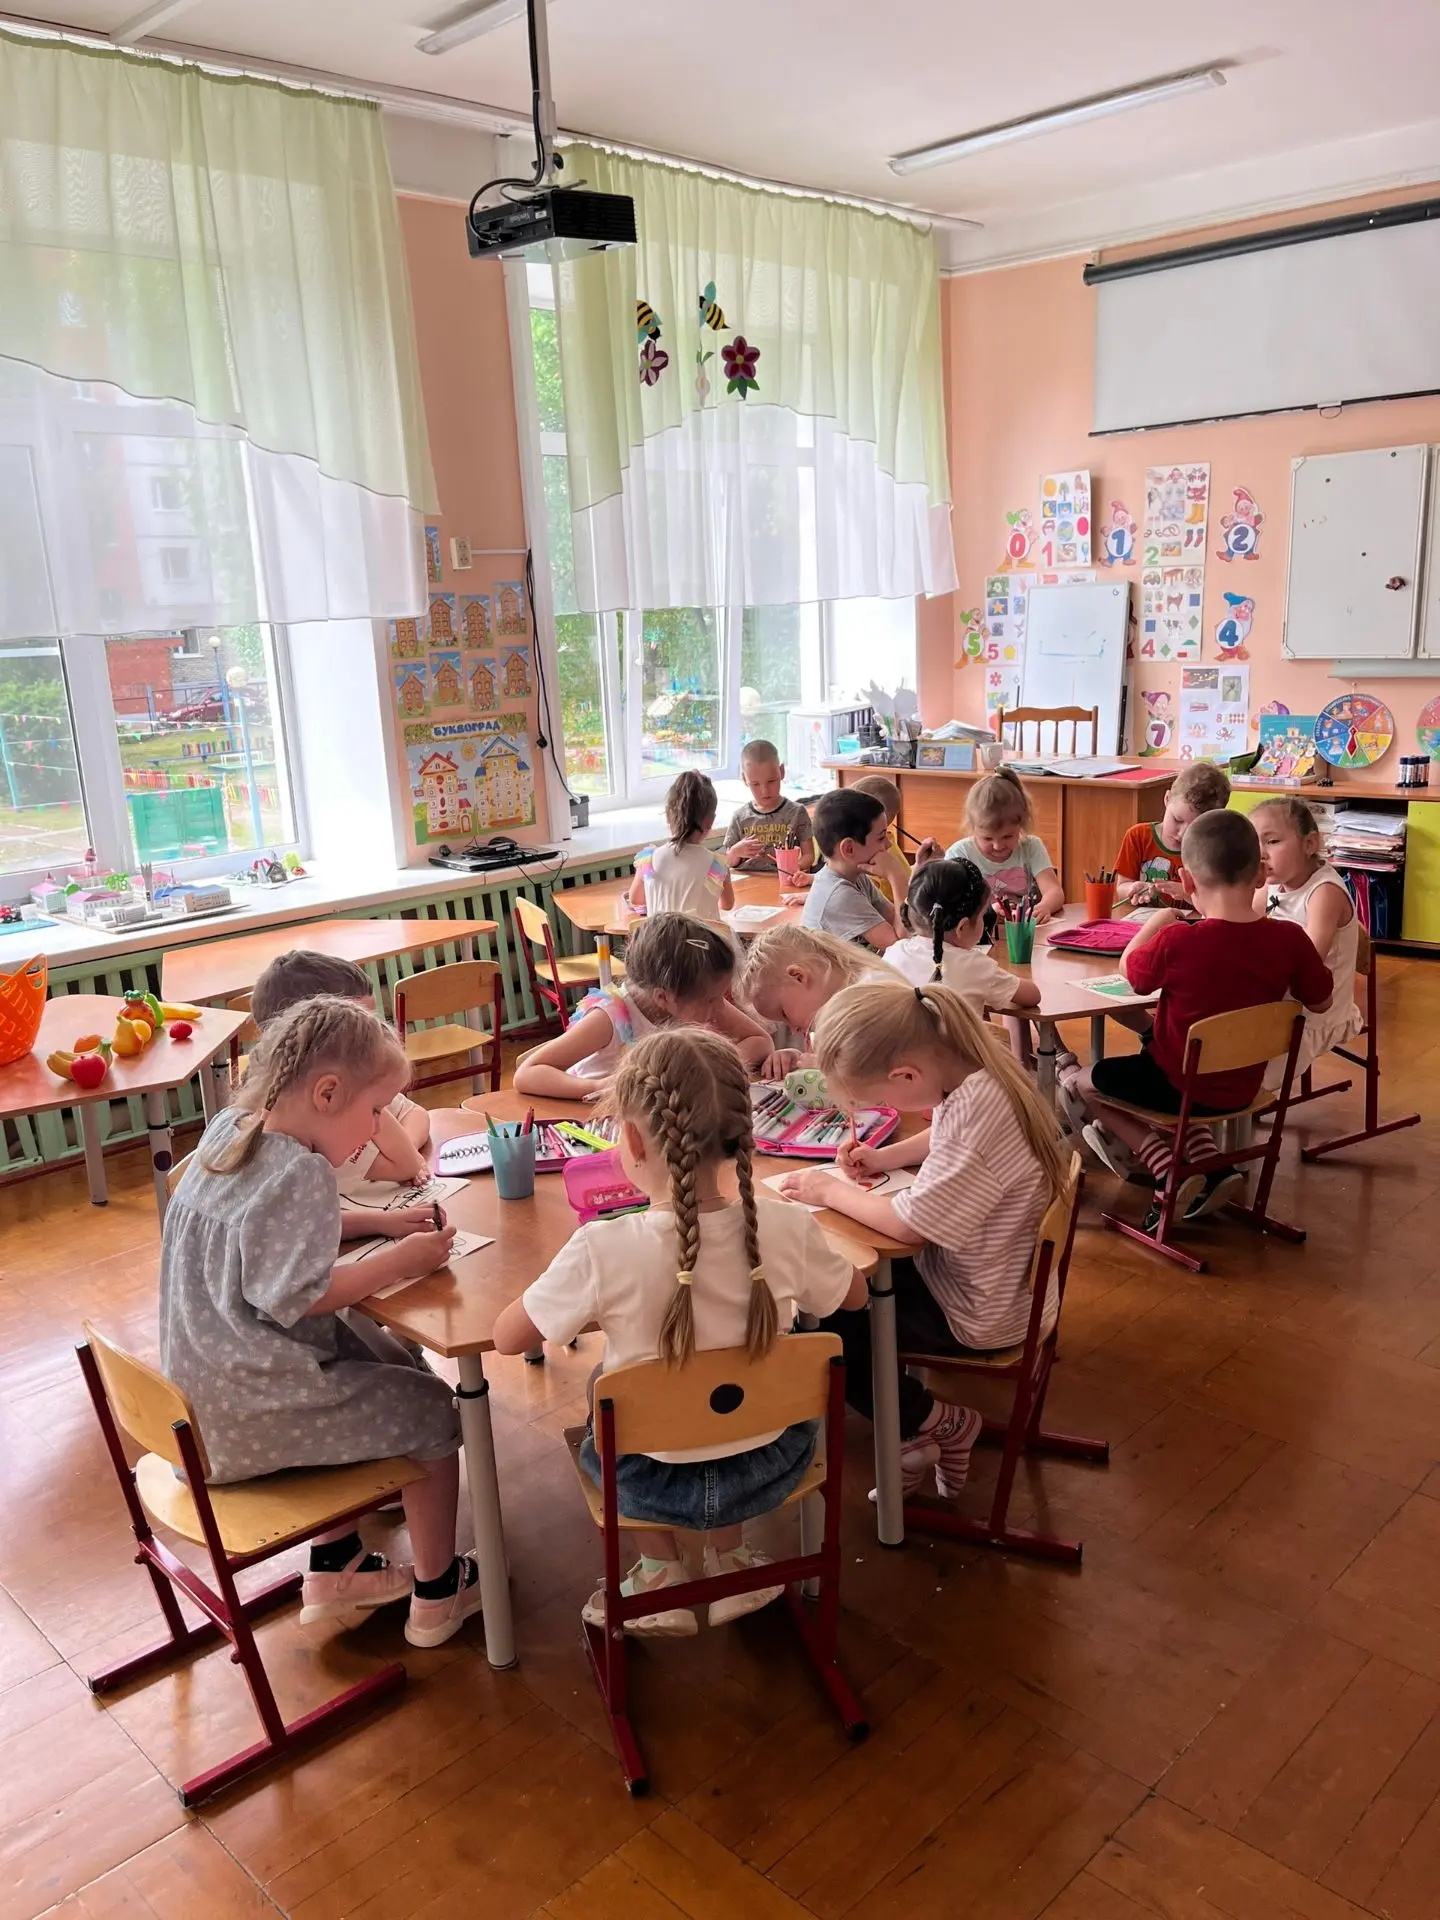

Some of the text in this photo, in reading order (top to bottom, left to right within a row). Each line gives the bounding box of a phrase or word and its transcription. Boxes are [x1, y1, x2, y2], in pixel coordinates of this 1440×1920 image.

[1010, 533, 1026, 558] 0
[1111, 529, 1125, 555] 1
[1232, 526, 1249, 551] 2
[1042, 541, 1053, 567] 1
[1145, 546, 1159, 565] 2
[968, 632, 981, 656] 5
[1219, 620, 1239, 647] 4
[987, 644, 999, 660] 5
[1141, 639, 1155, 658] 4
[434, 720, 501, 736] БУКВОГРАД
[1151, 723, 1166, 747] 7
[743, 824, 792, 835] DINOSAURS
